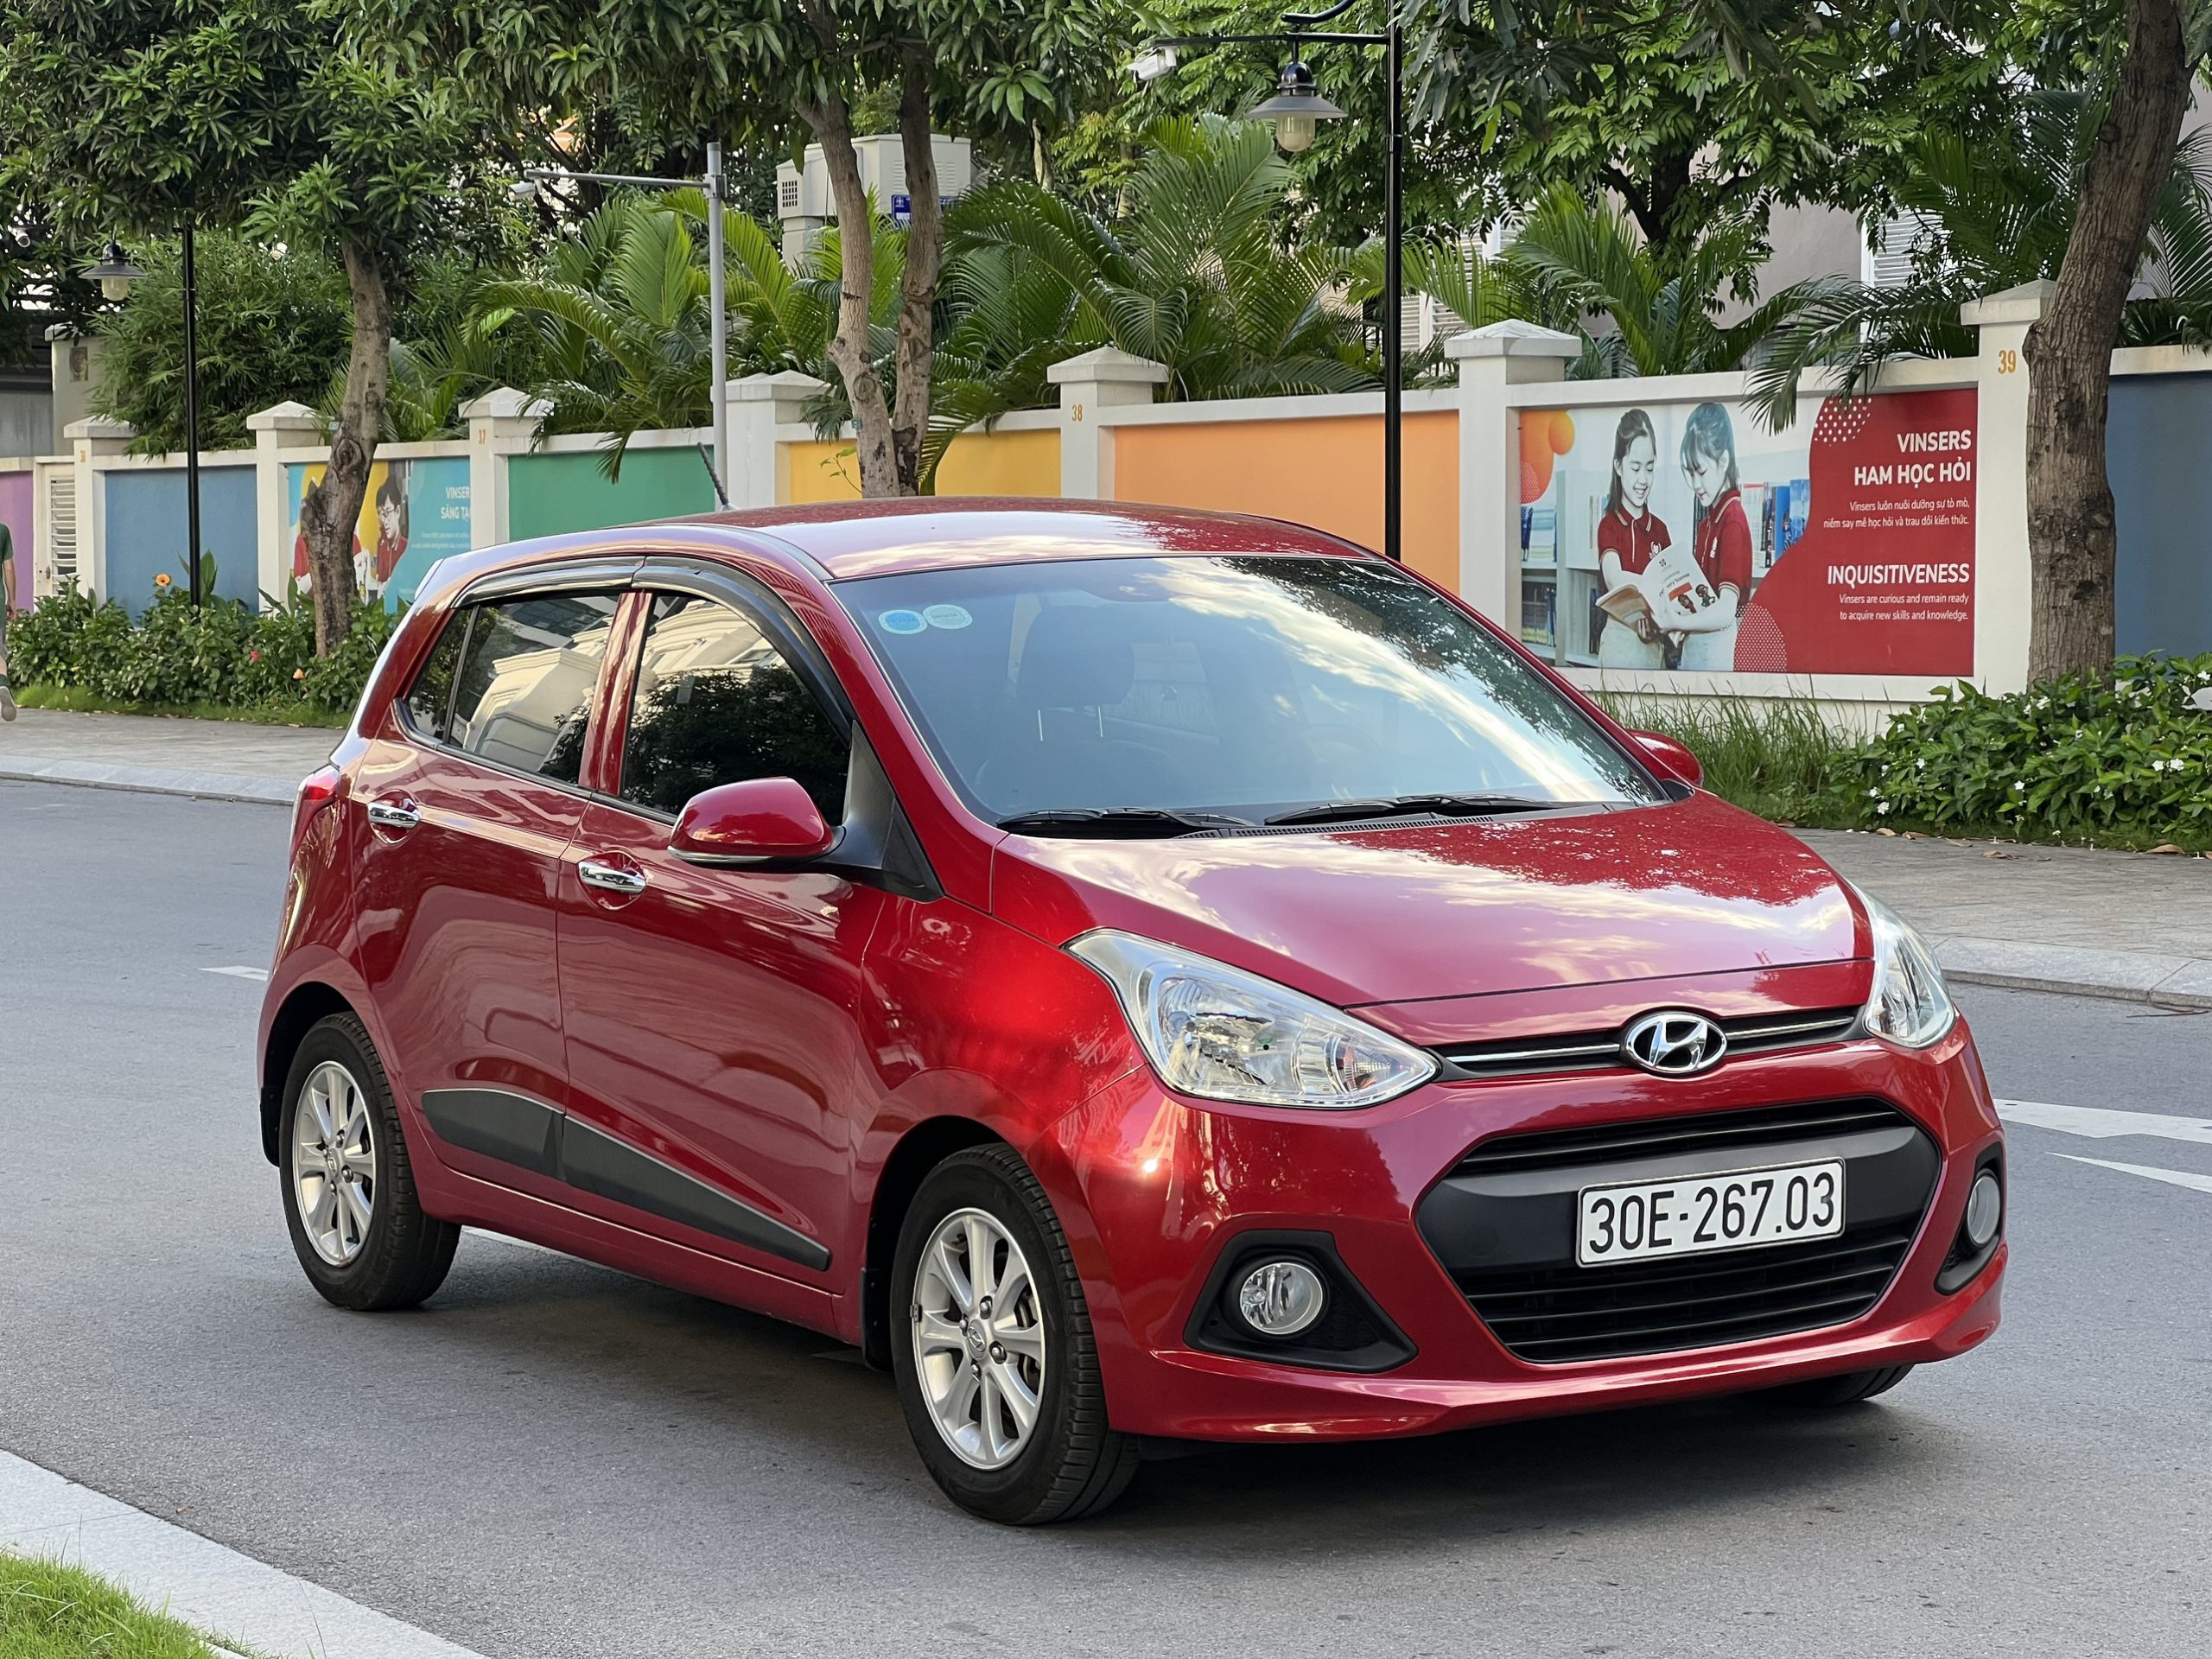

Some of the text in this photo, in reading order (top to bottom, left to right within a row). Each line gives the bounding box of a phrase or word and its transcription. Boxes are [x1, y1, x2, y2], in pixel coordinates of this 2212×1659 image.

[1998, 349, 2017, 375] 39
[1071, 404, 1083, 423] 38
[478, 429, 486, 445] 37
[1897, 430, 1972, 453] VINSERS
[1854, 456, 1971, 488] HAM HỌC HỎI
[441, 503, 470, 522] SÁNG TẠ
[1850, 497, 1970, 512] Vinsers luôn nuôi dưỡng sự tò mò,
[1842, 520, 1854, 529] say
[1855, 517, 1866, 527] mê
[1868, 517, 1881, 529] học
[1883, 516, 1894, 526] hỏi
[1895, 516, 1904, 526] và
[1905, 518, 1920, 526] trau
[1935, 514, 1949, 525] kiến
[1951, 513, 1969, 524] thức.
[1827, 563, 1970, 589] INQUISITIVENESS
[1839, 592, 1969, 605] Vinsers are curious and remain ready
[1840, 608, 1969, 621] to acquire new skills and knowledge.
[1589, 1171, 1834, 1254] 30E-267.03
